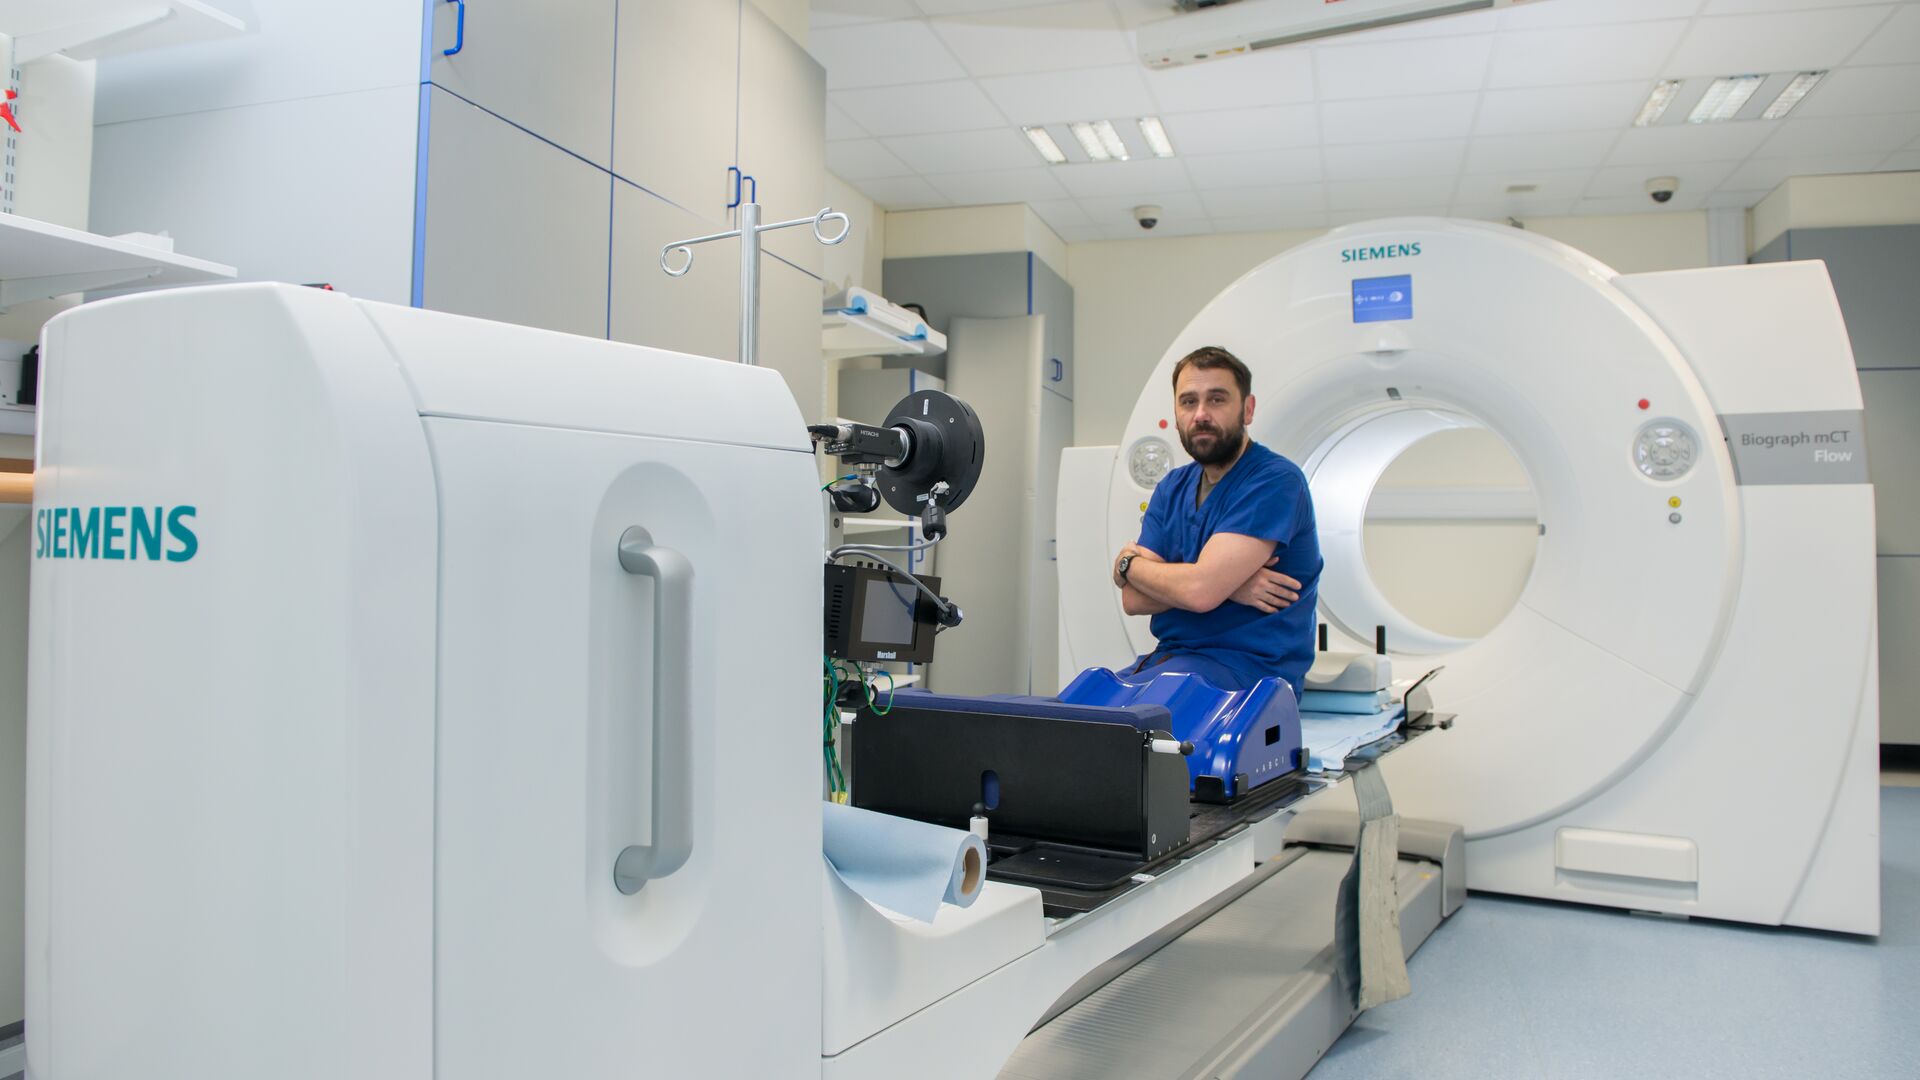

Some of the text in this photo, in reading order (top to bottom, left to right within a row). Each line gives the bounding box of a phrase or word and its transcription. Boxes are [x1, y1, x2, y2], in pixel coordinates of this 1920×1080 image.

[1341, 242, 1421, 263] SIEMENS
[1741, 430, 1850, 449] Biograph mCT
[1814, 449, 1853, 463] Flow
[36, 505, 199, 563] SIEMENS
[877, 651, 896, 659] Marshall
